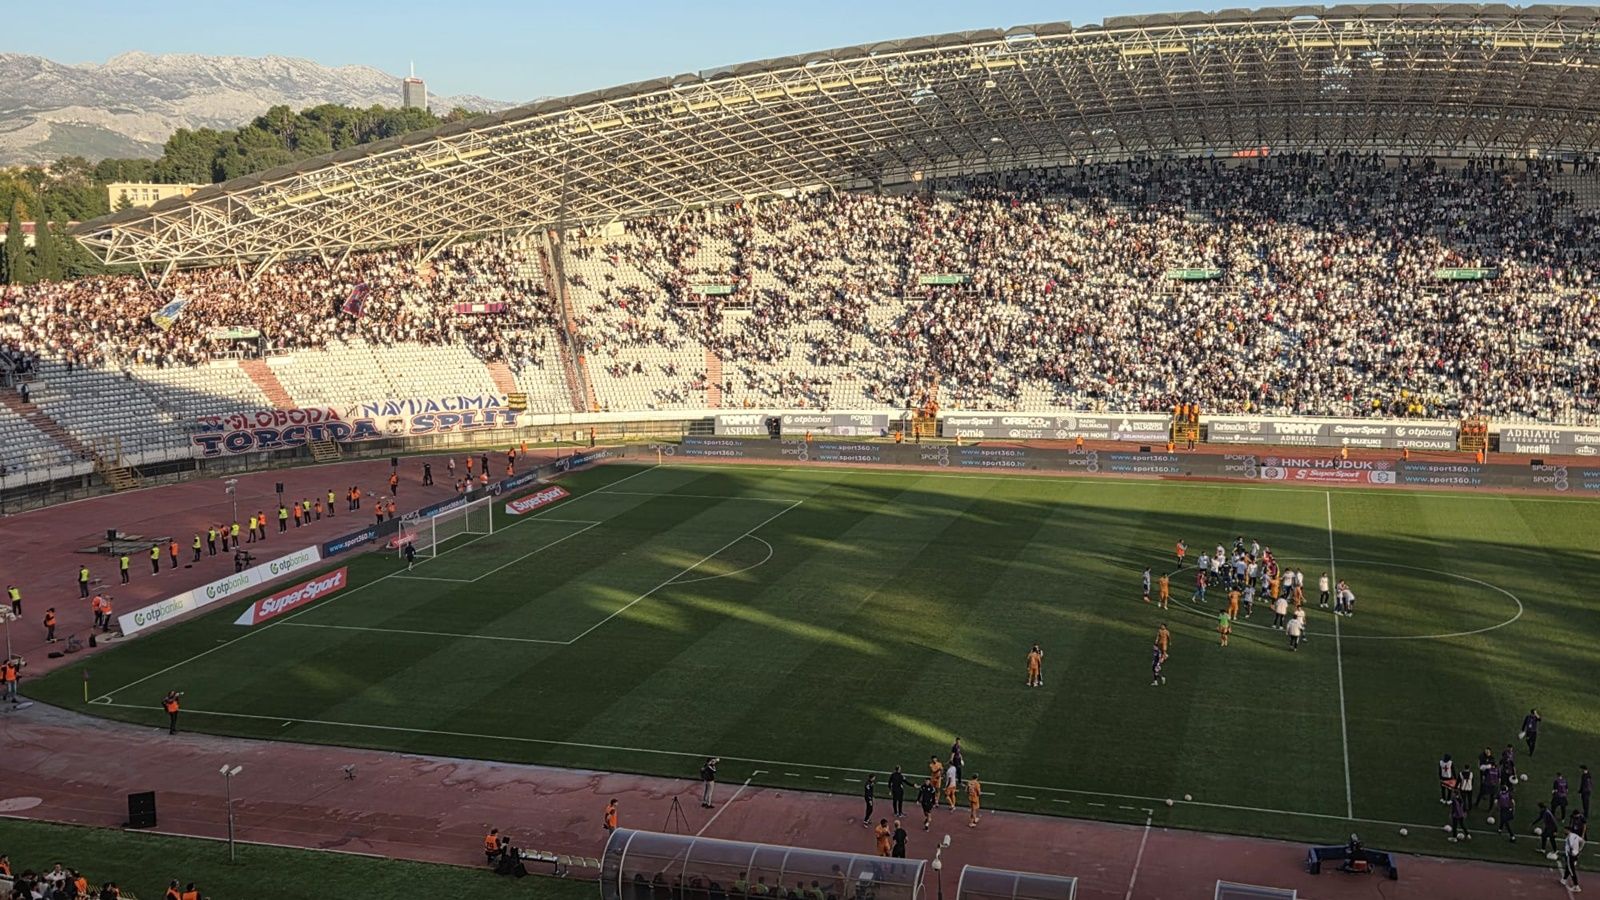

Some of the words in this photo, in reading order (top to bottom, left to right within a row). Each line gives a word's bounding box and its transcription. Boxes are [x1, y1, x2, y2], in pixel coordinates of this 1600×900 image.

[231, 408, 340, 430] SLOBODA
[362, 395, 500, 418] NAVIJACIMA
[720, 414, 762, 425] TOMMY
[794, 416, 832, 424] otpbanka
[947, 417, 994, 426] SuperSport
[193, 418, 382, 456] TORCIDA
[410, 407, 524, 434] SPLIT
[724, 426, 760, 435] ASPIRA
[1273, 422, 1322, 434] TOMMY
[1334, 425, 1387, 435] SuperSport
[1408, 427, 1453, 437] otpbanka
[1507, 429, 1560, 439] ADRIATIC
[1397, 440, 1451, 449] EURODAUS
[1281, 458, 1310, 467] HNK
[1310, 468, 1359, 478] SuperSport
[1404, 464, 1481, 473] www.sport360.hr
[1405, 474, 1482, 484] www.sport360.hr
[513, 488, 565, 510] SuperSport
[279, 552, 310, 572] otpbanka
[216, 574, 249, 596] otpbanka
[259, 572, 342, 617] SuperSport
[146, 599, 183, 622] otpbanka
